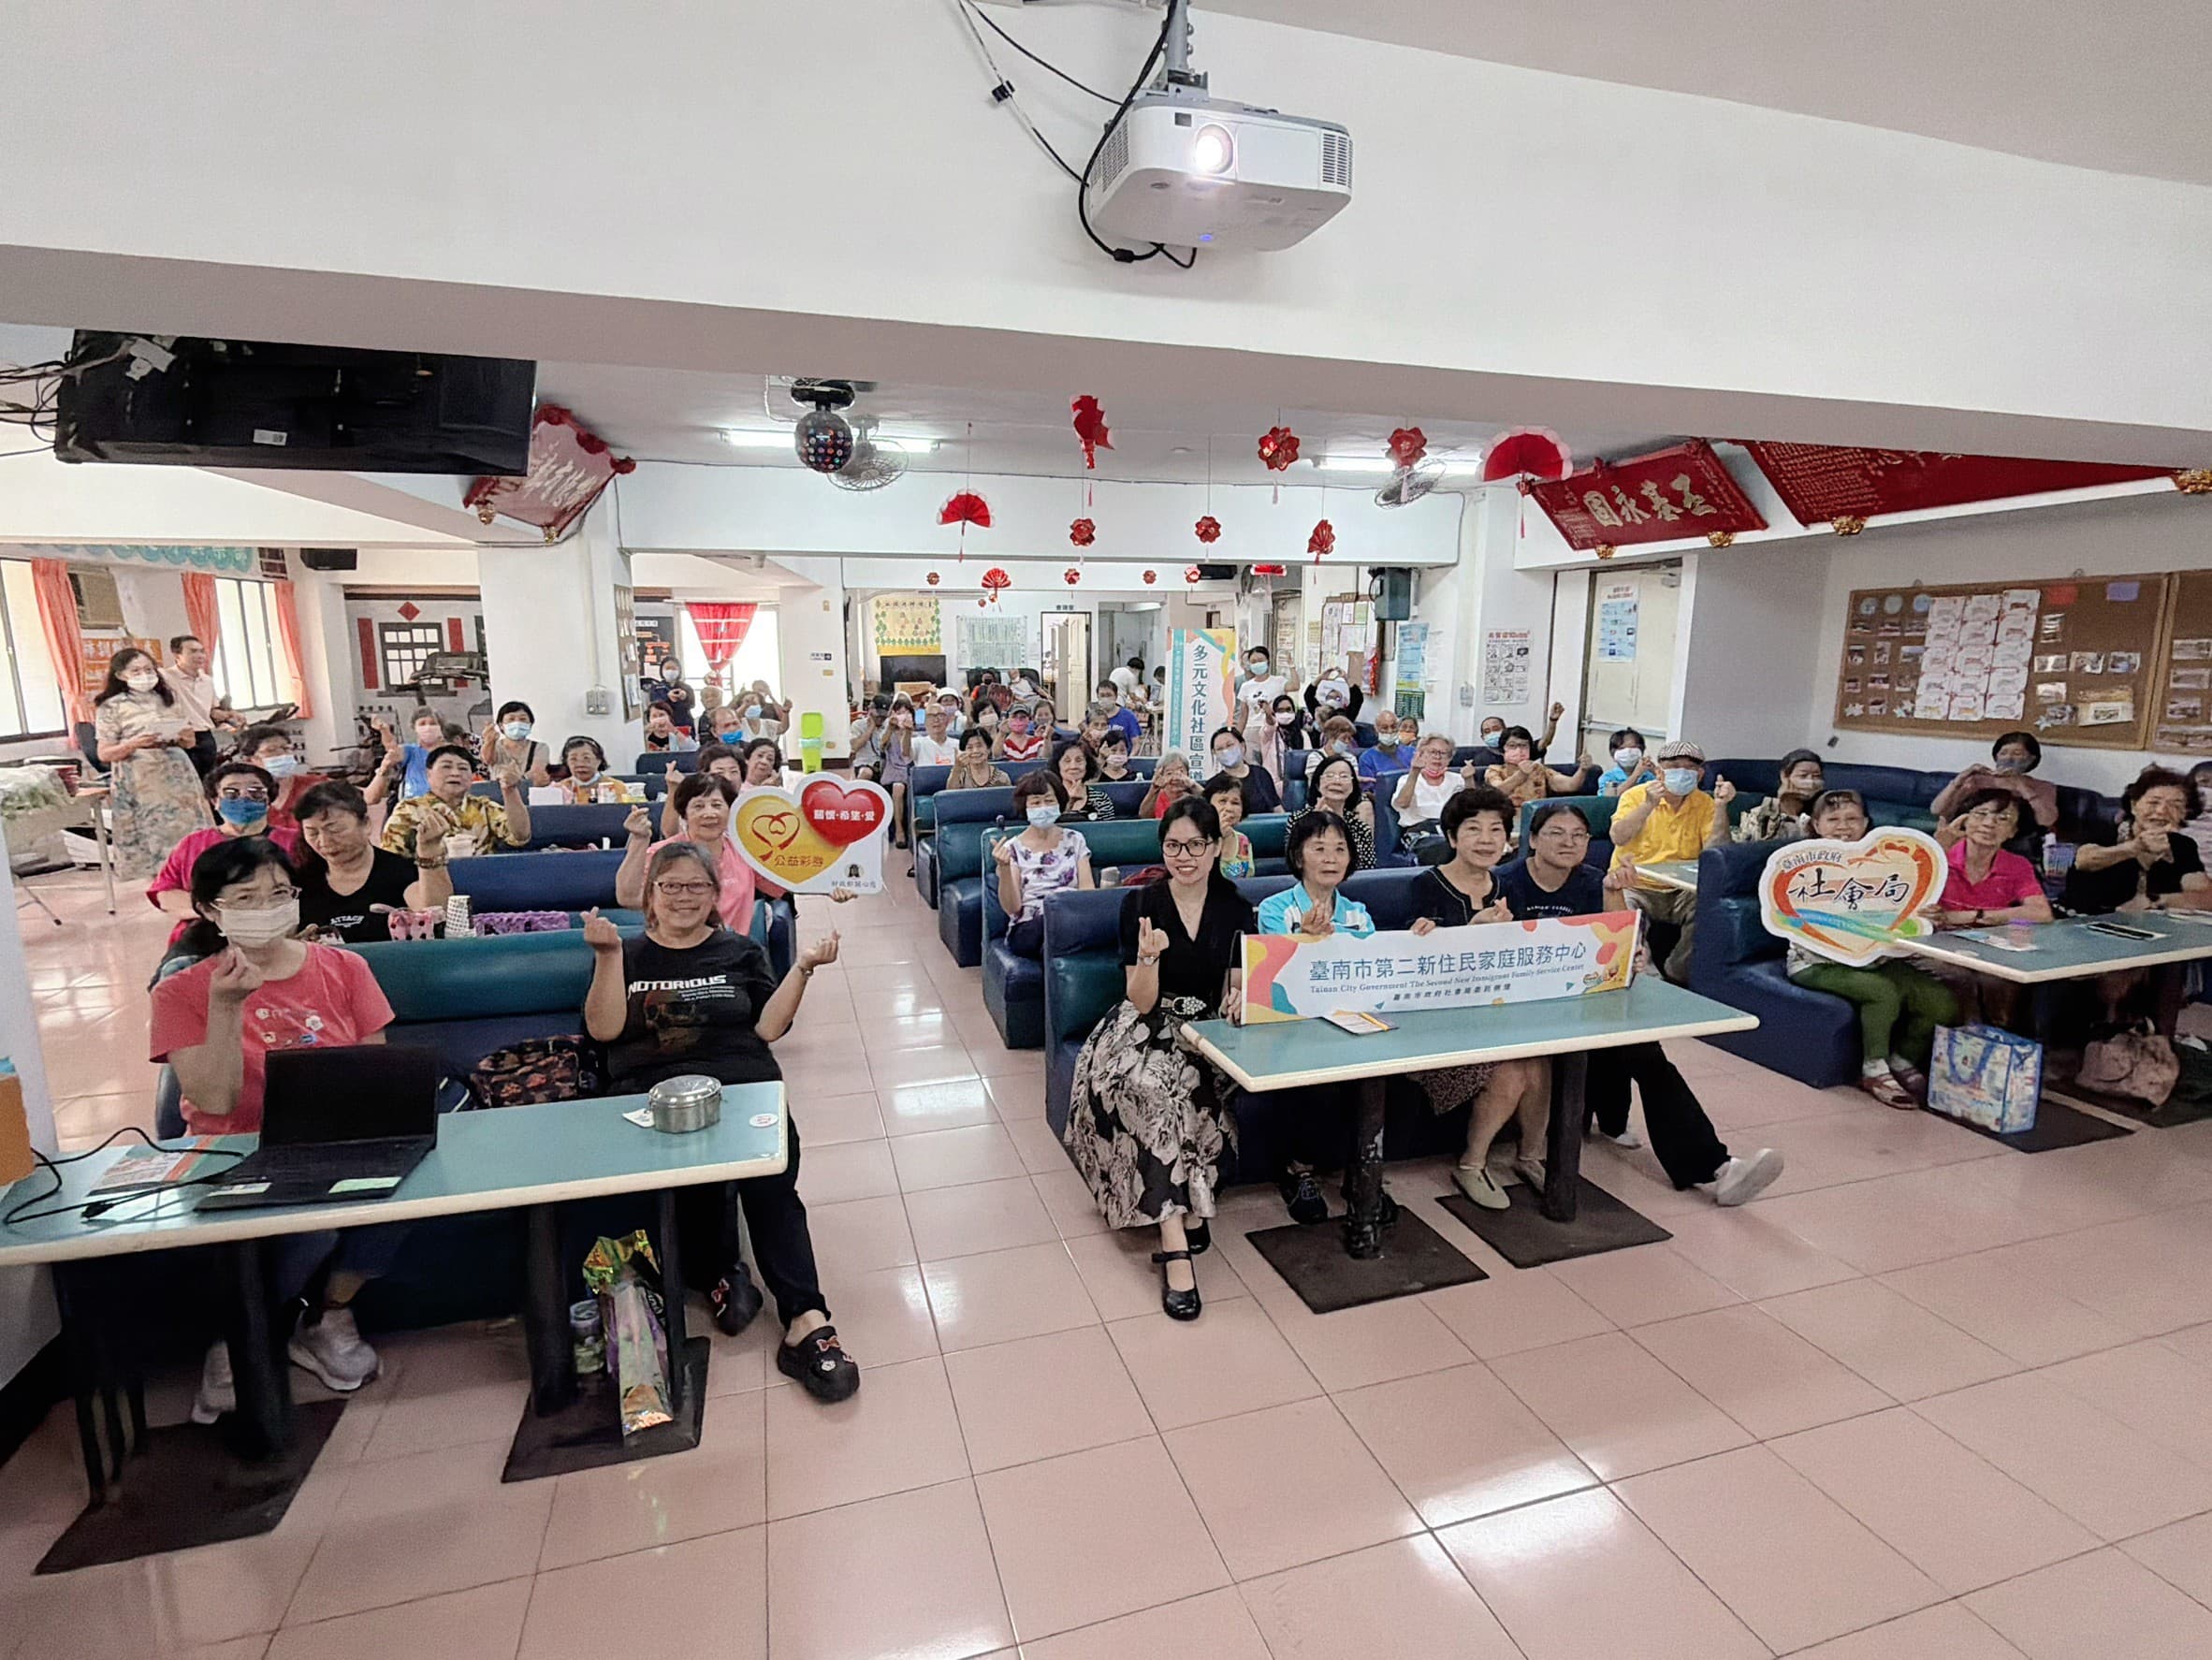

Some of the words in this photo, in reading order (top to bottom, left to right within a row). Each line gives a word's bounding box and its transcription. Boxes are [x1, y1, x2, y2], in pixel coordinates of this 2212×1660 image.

[1788, 867, 1910, 910] 社會局
[1310, 941, 1586, 981] 臺南市第二新住民家庭服務中心
[628, 975, 727, 1000] NOTORIOUS
[1310, 985, 1338, 994] Tainan
[1340, 983, 1357, 994] City
[1359, 983, 1407, 992] Government
